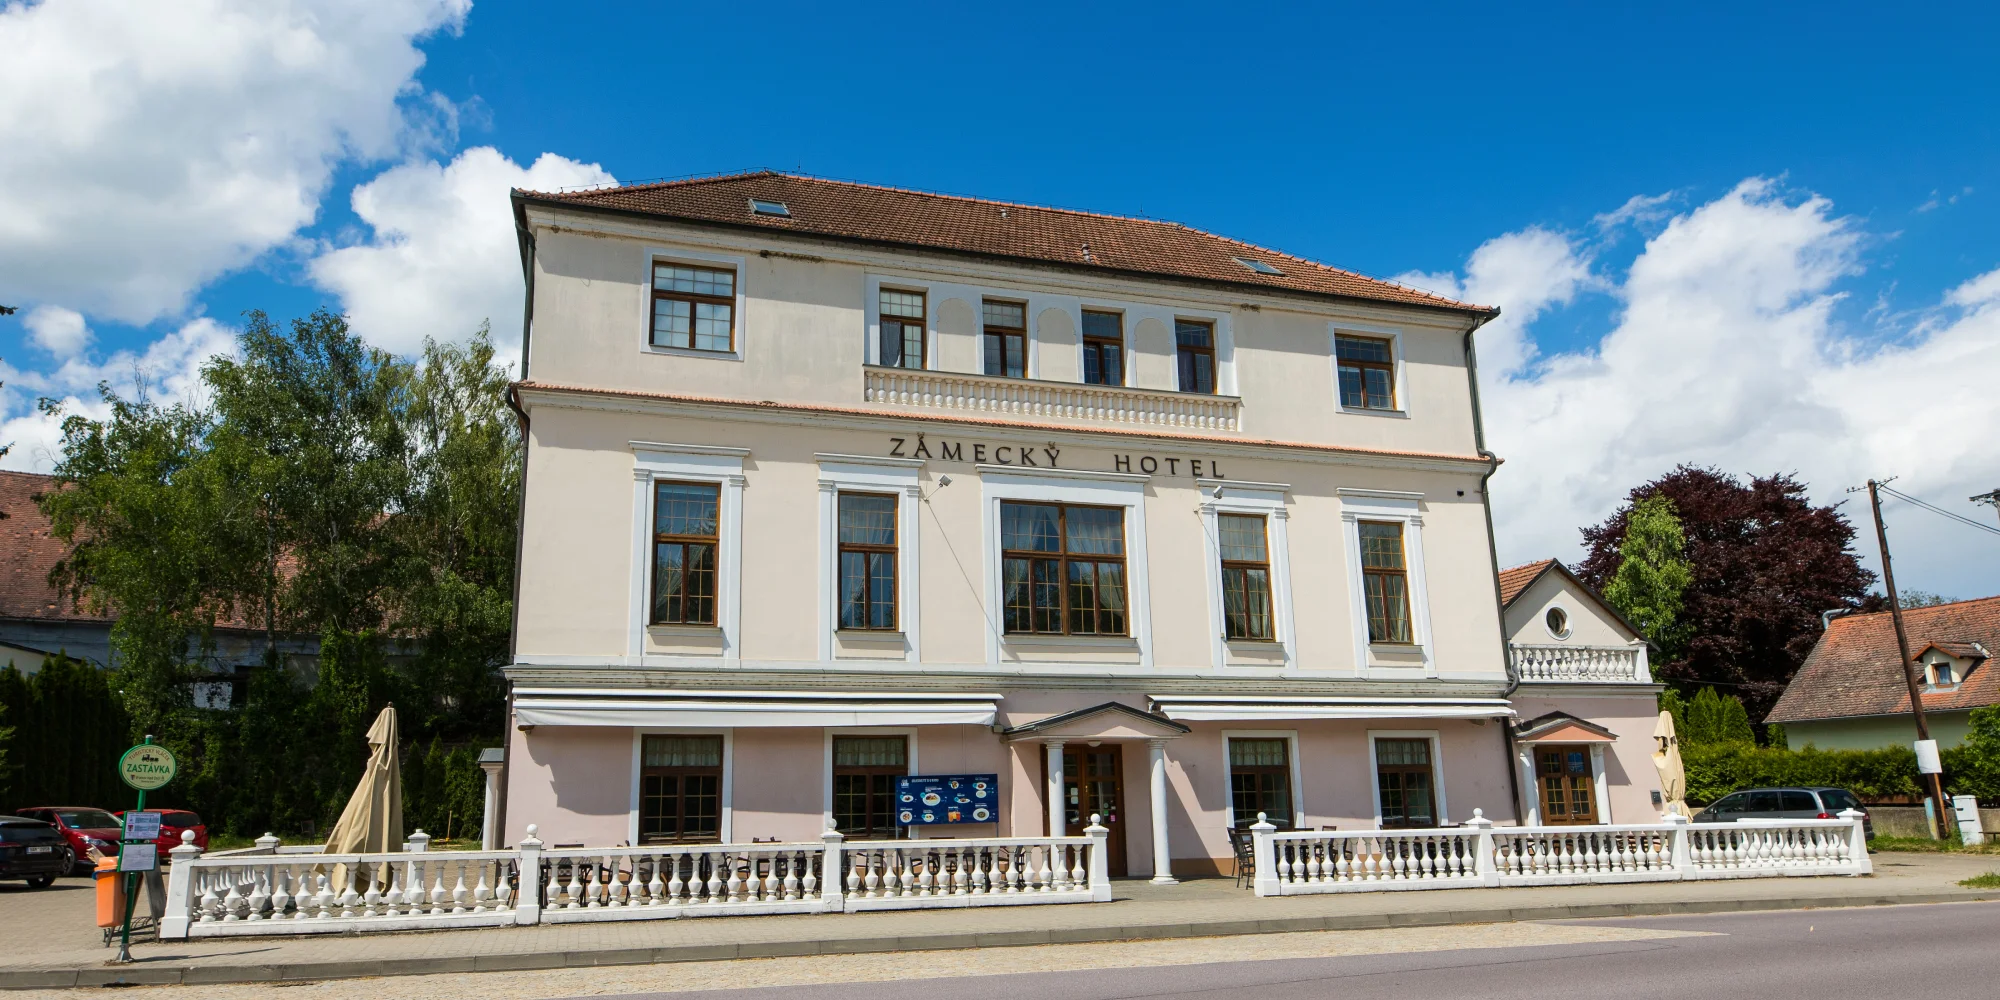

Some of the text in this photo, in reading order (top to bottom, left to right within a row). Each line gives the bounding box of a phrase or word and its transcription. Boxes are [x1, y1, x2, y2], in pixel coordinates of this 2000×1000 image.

[890, 434, 1225, 478] ZÁMECKÝ HOTEL
[127, 763, 170, 773] ZASTÁVKA
